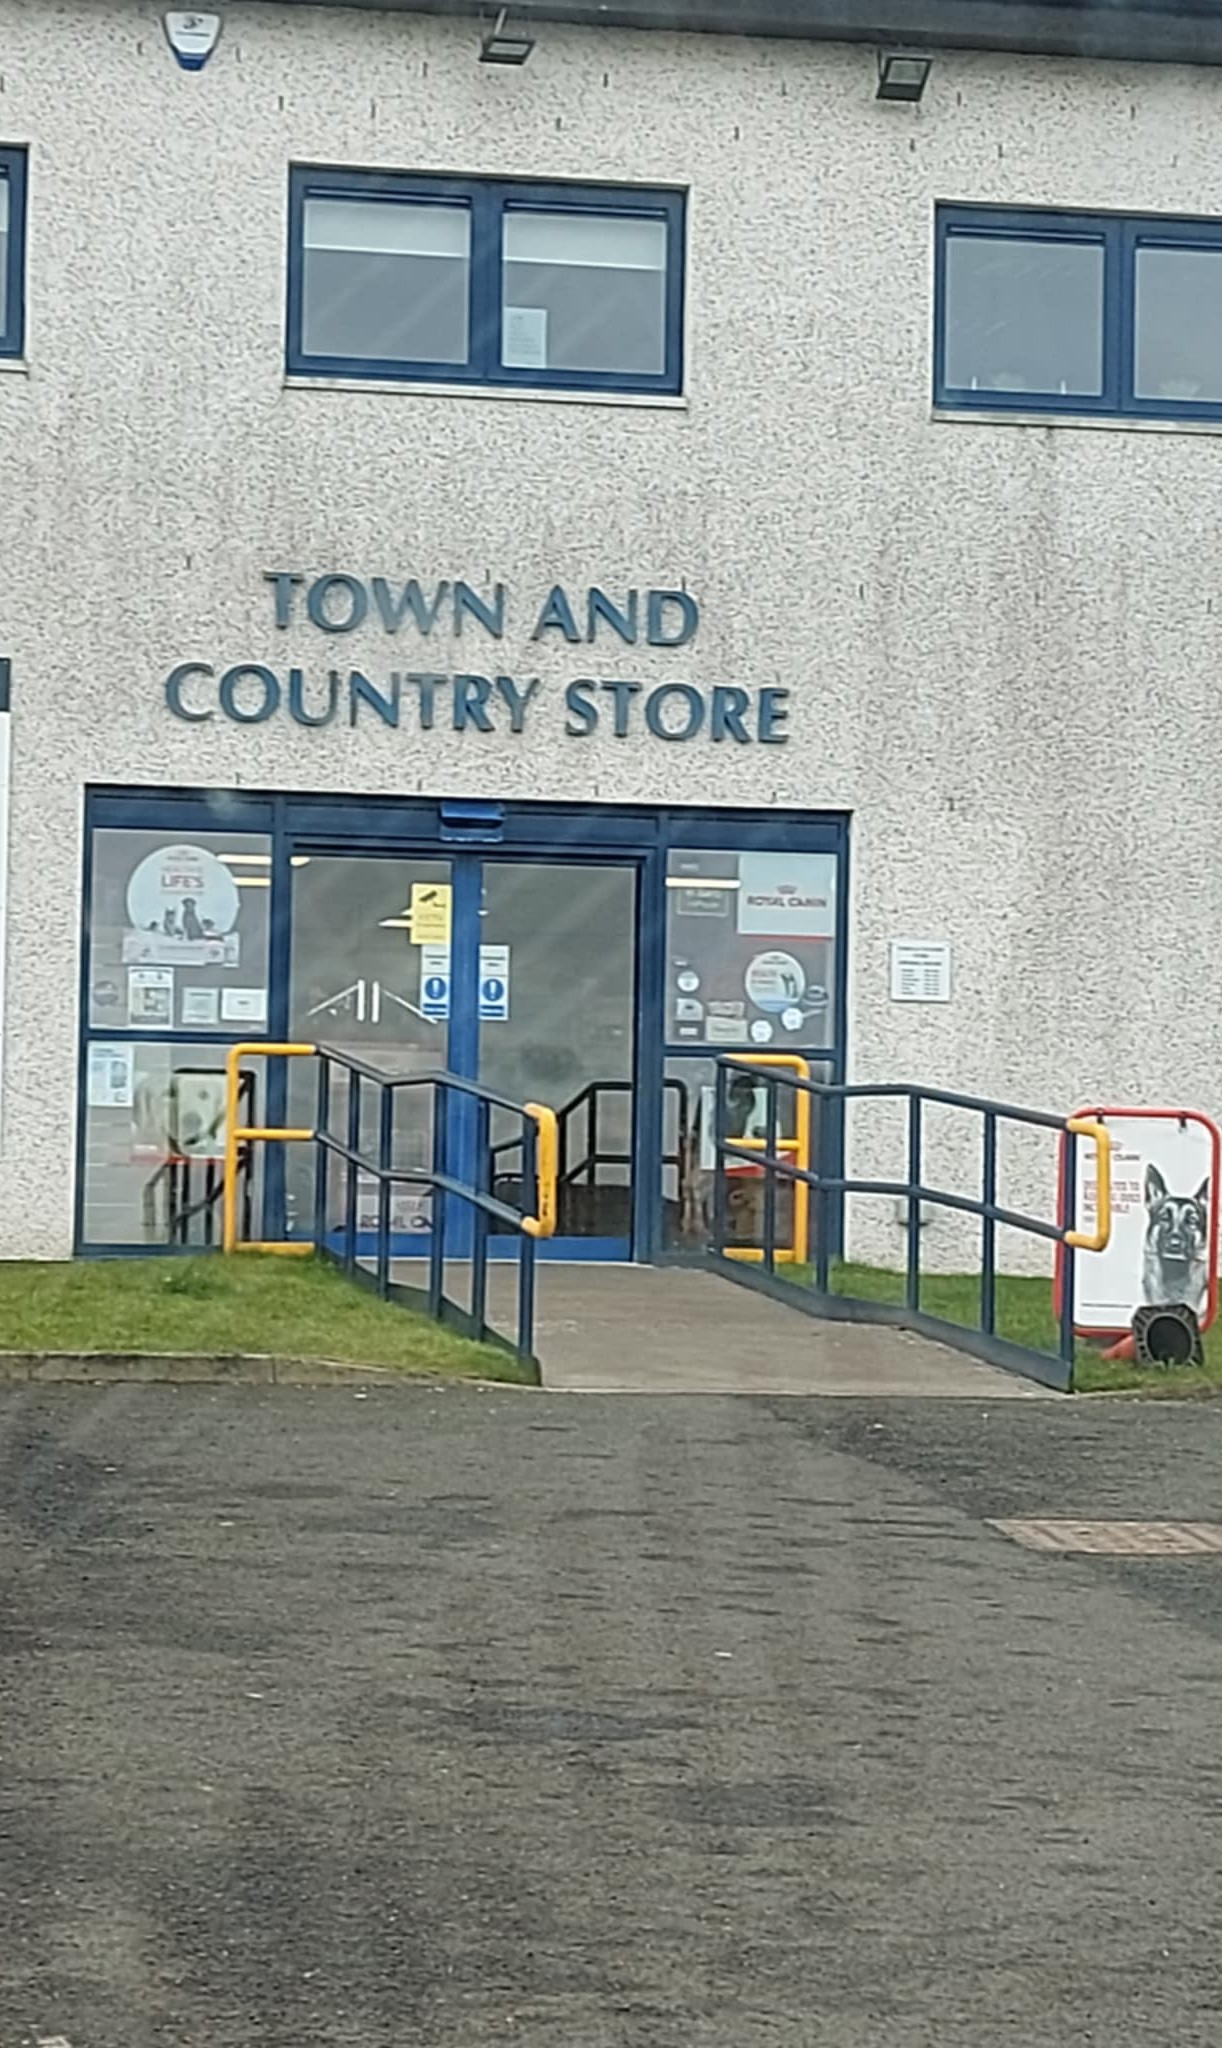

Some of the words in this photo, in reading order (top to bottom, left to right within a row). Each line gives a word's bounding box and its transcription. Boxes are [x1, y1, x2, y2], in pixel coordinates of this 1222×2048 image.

[264, 572, 505, 638] TOWN
[531, 584, 701, 646] AND
[165, 661, 540, 733] COUNTRY
[564, 678, 791, 744] STORE
